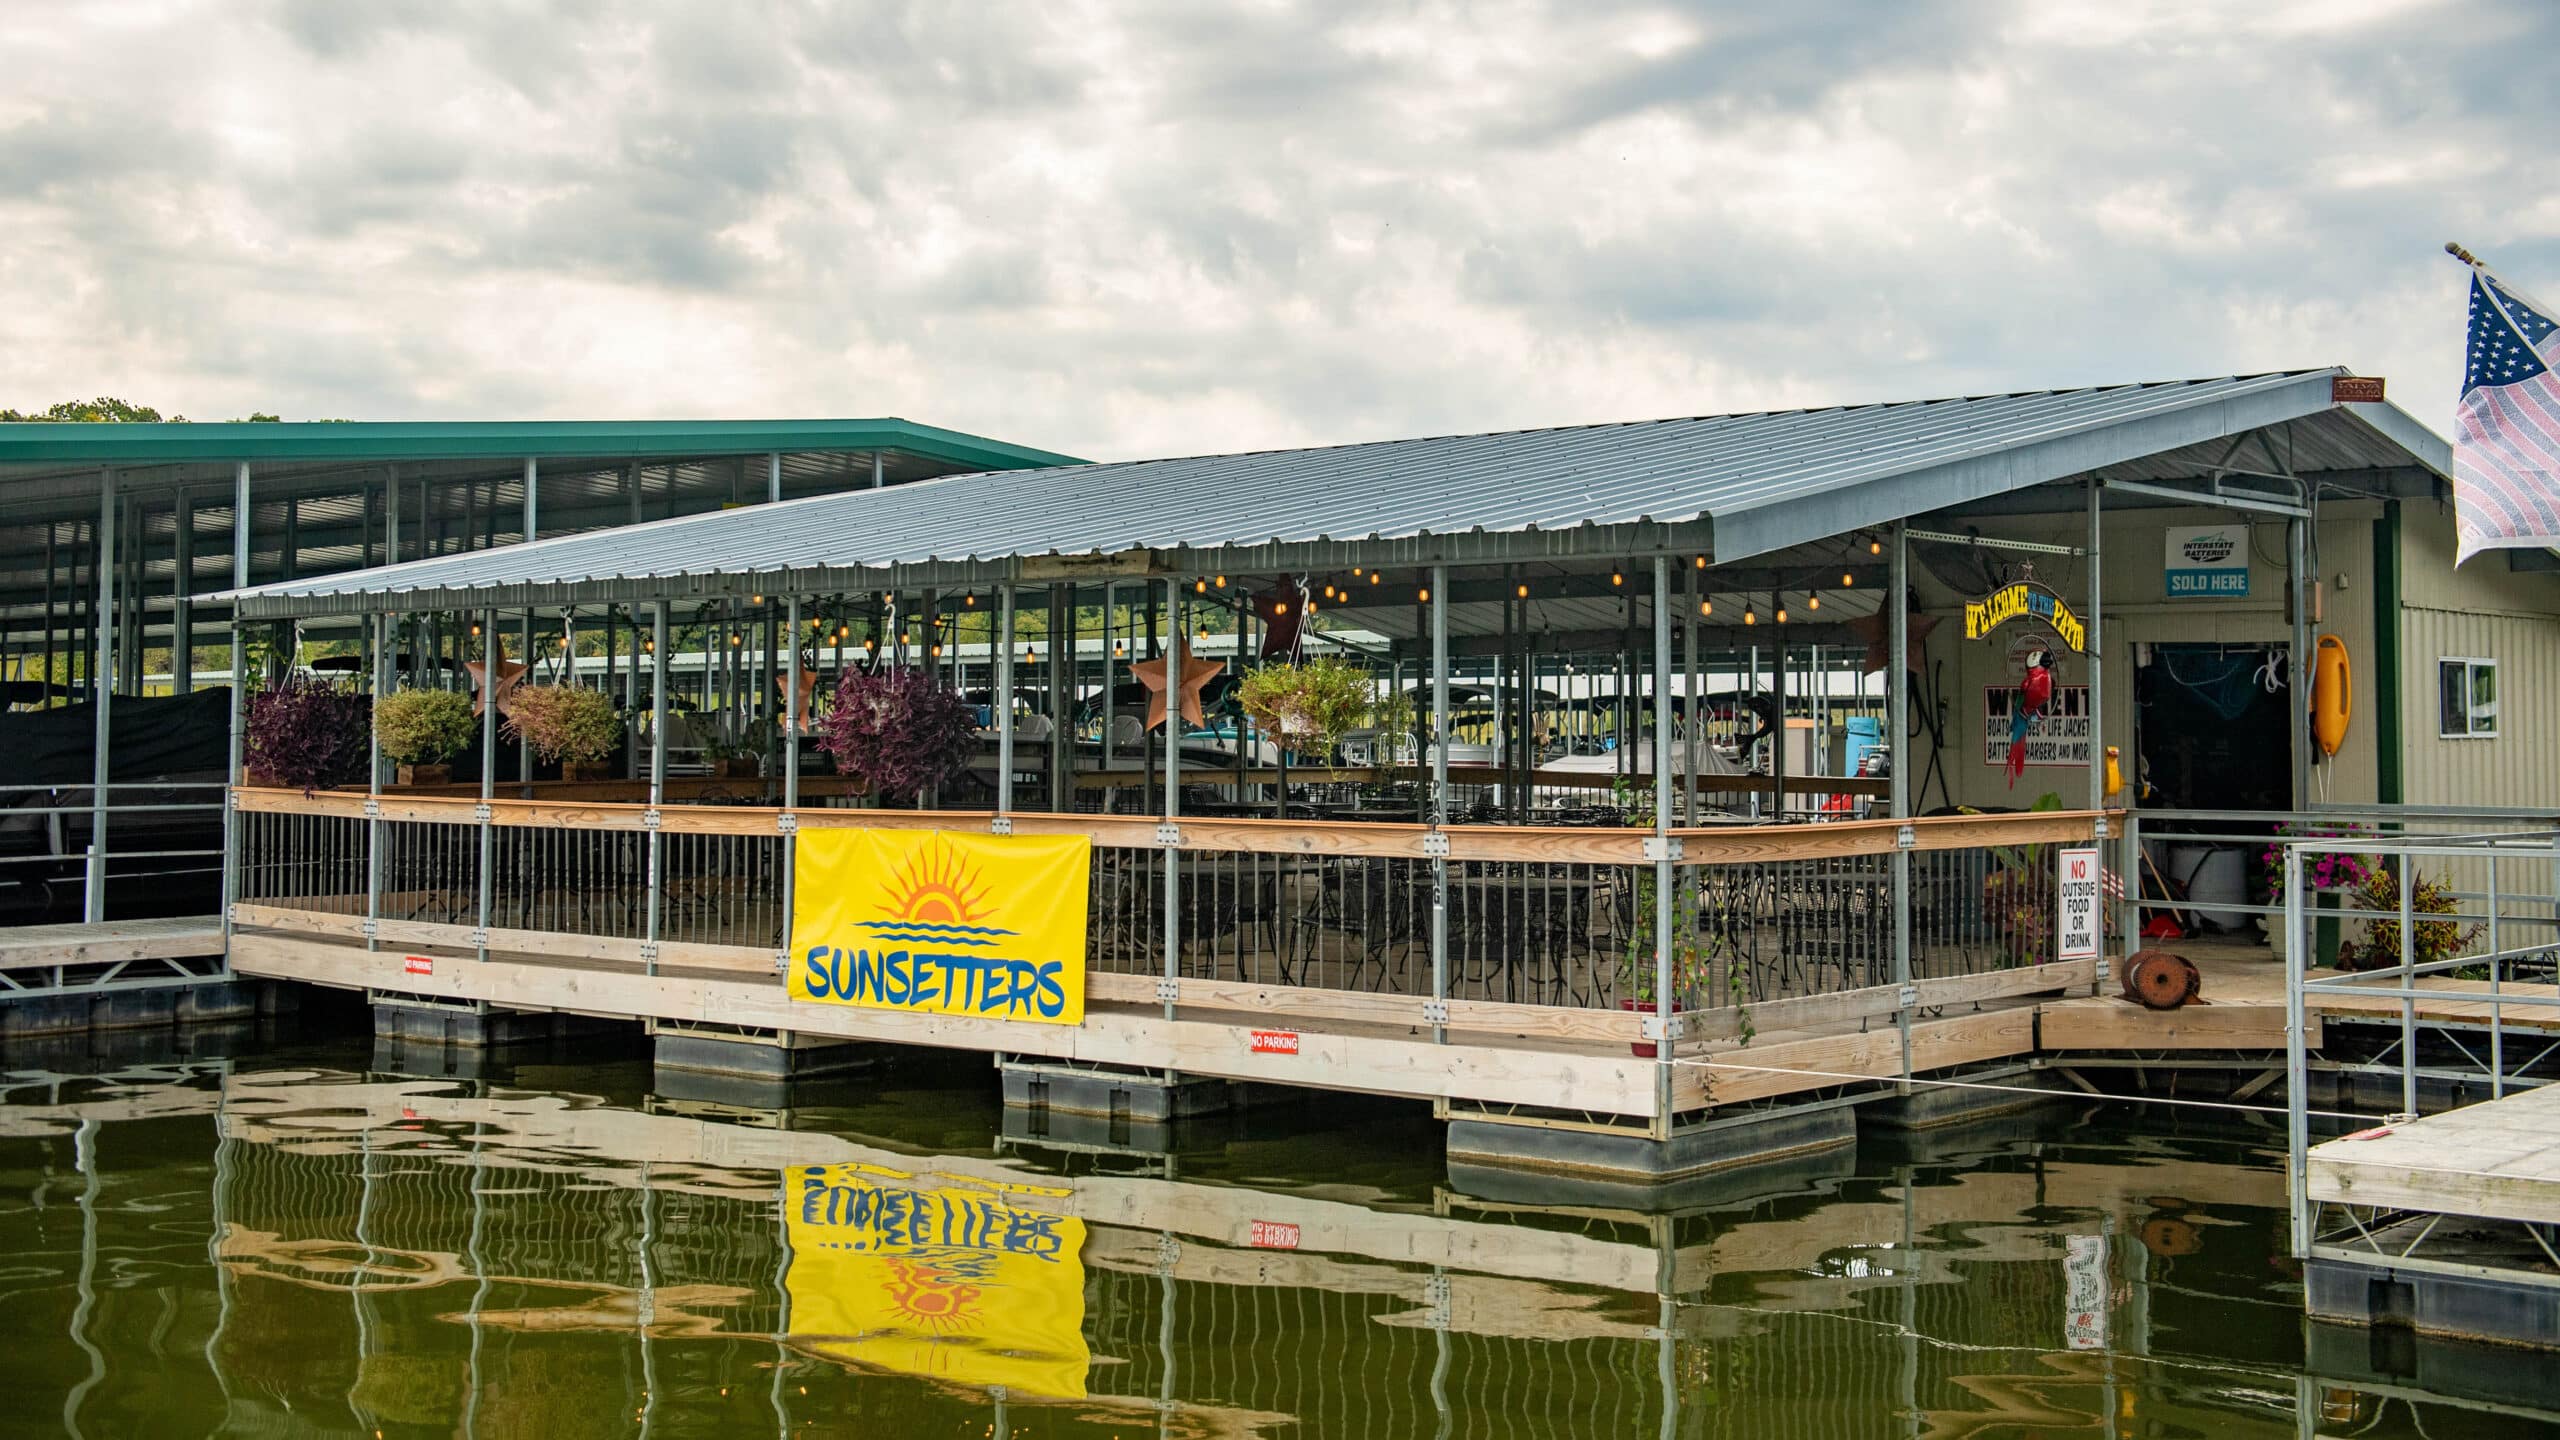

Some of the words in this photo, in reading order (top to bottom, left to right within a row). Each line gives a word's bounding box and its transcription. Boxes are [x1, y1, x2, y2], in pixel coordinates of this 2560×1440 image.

[2184, 549, 2231, 557] BATTERIES
[2172, 575, 2207, 591] SOLD
[2211, 575, 2246, 590] HERE
[1966, 585, 2028, 639] WELCOME
[2028, 591, 2037, 612] TO
[2051, 599, 2084, 652] PATIO
[1988, 718, 2010, 737] BOATS
[2048, 718, 2061, 737] LIFE
[2025, 742, 2057, 760] HARGERS
[2059, 744, 2070, 759] AND
[2072, 742, 2090, 760] MOR
[2071, 859, 2086, 880] NO
[2062, 882, 2095, 898] OUTSIDE
[2067, 899, 2090, 914] FOOD
[2072, 916, 2084, 930] OR
[2065, 932, 2091, 949] DRINK
[805, 945, 1065, 1018] SUNSETTERS
[1251, 1035, 1263, 1047] NO
[1263, 1036, 1298, 1050] PARKING
